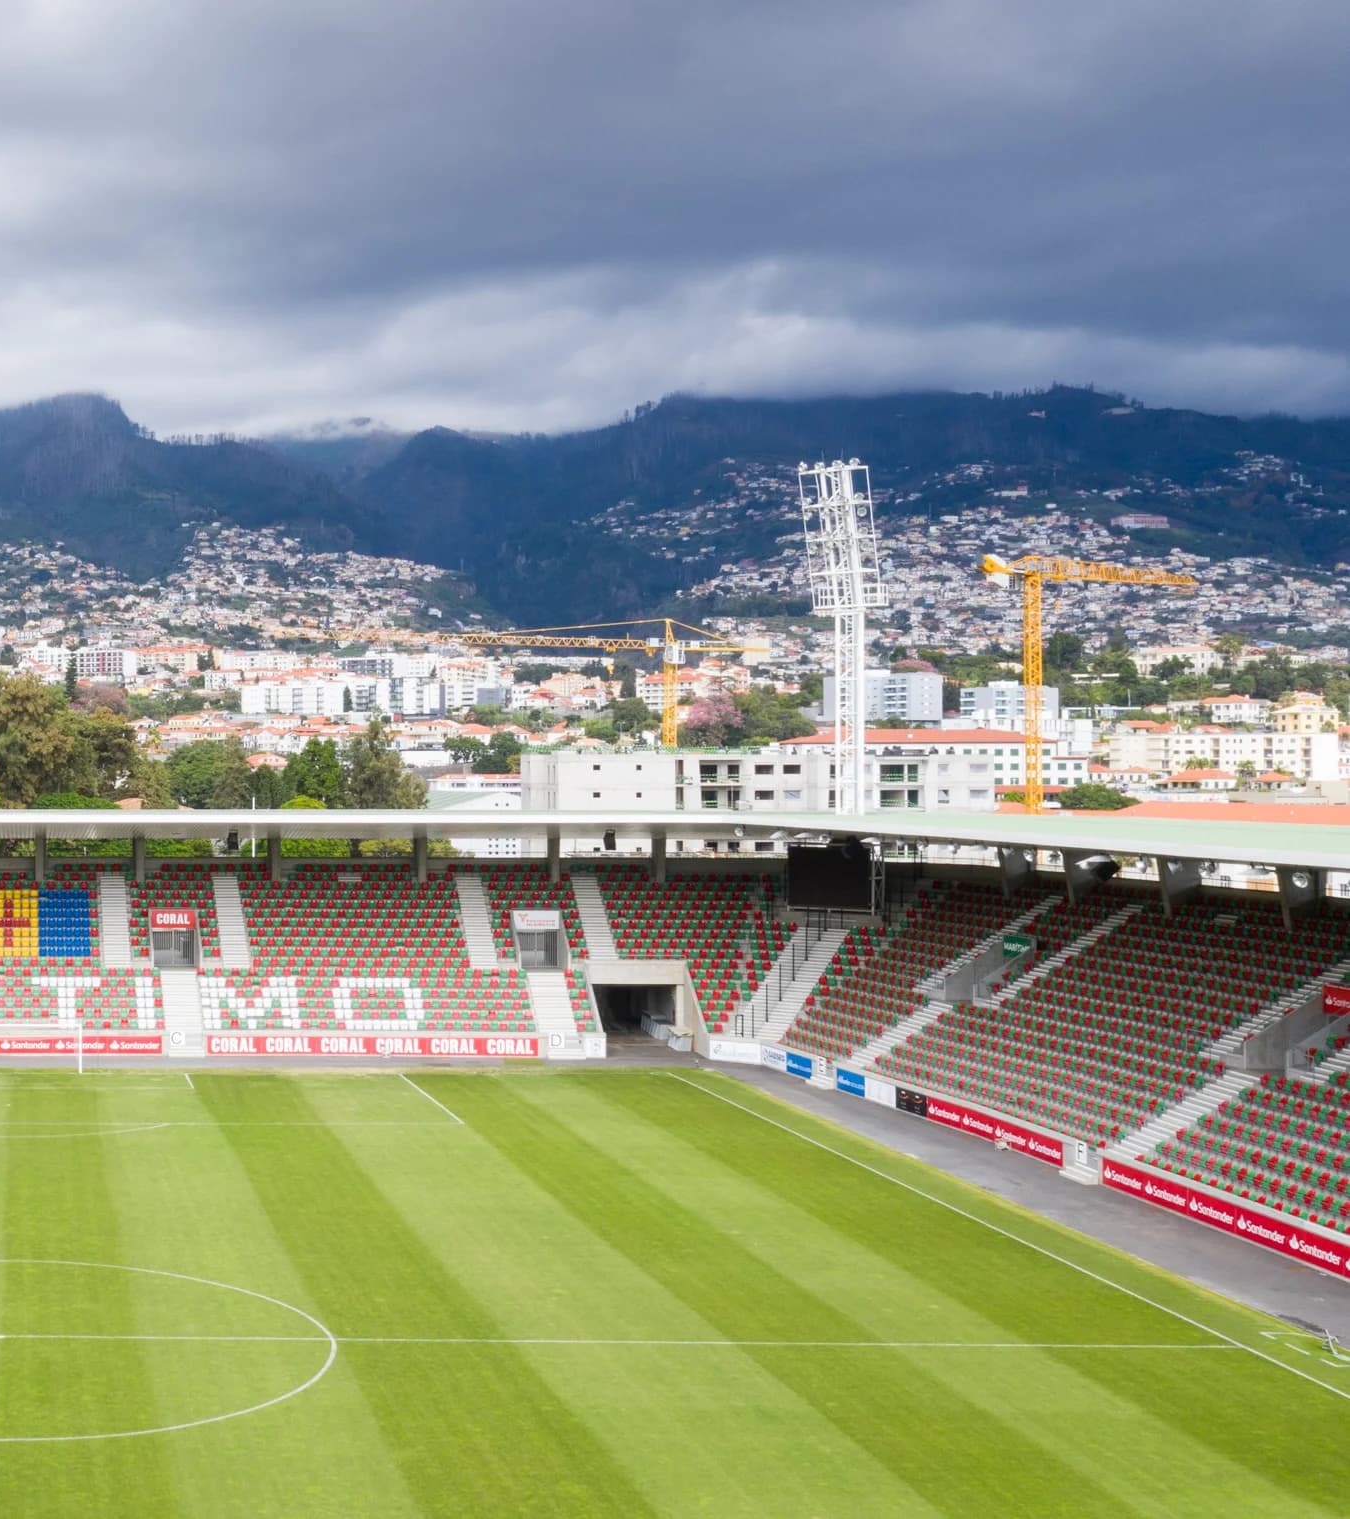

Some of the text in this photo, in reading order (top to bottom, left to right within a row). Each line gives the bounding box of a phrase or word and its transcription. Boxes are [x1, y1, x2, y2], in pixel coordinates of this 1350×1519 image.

[156, 912, 191, 925] CORAL
[10, 1041, 50, 1050] Santander
[120, 1041, 160, 1050] Santander
[171, 1031, 183, 1045] C
[211, 1037, 257, 1053] CORAL
[265, 1037, 312, 1053] CORAL
[320, 1037, 367, 1053] CORAL
[376, 1037, 422, 1054] CORAL
[431, 1038, 478, 1054] CORAL
[486, 1038, 534, 1055] CORAL
[551, 1034, 562, 1047] D
[934, 1107, 961, 1124] Santander
[969, 1117, 994, 1134] Santander
[1001, 1128, 1027, 1147] Santander
[1034, 1142, 1062, 1160] Santander
[1078, 1143, 1085, 1161] F
[1111, 1169, 1142, 1190] Santander
[1152, 1185, 1187, 1207] Santander
[1197, 1200, 1235, 1225] Santander
[1246, 1219, 1286, 1245] Santander
[1298, 1239, 1342, 1266] Santander
